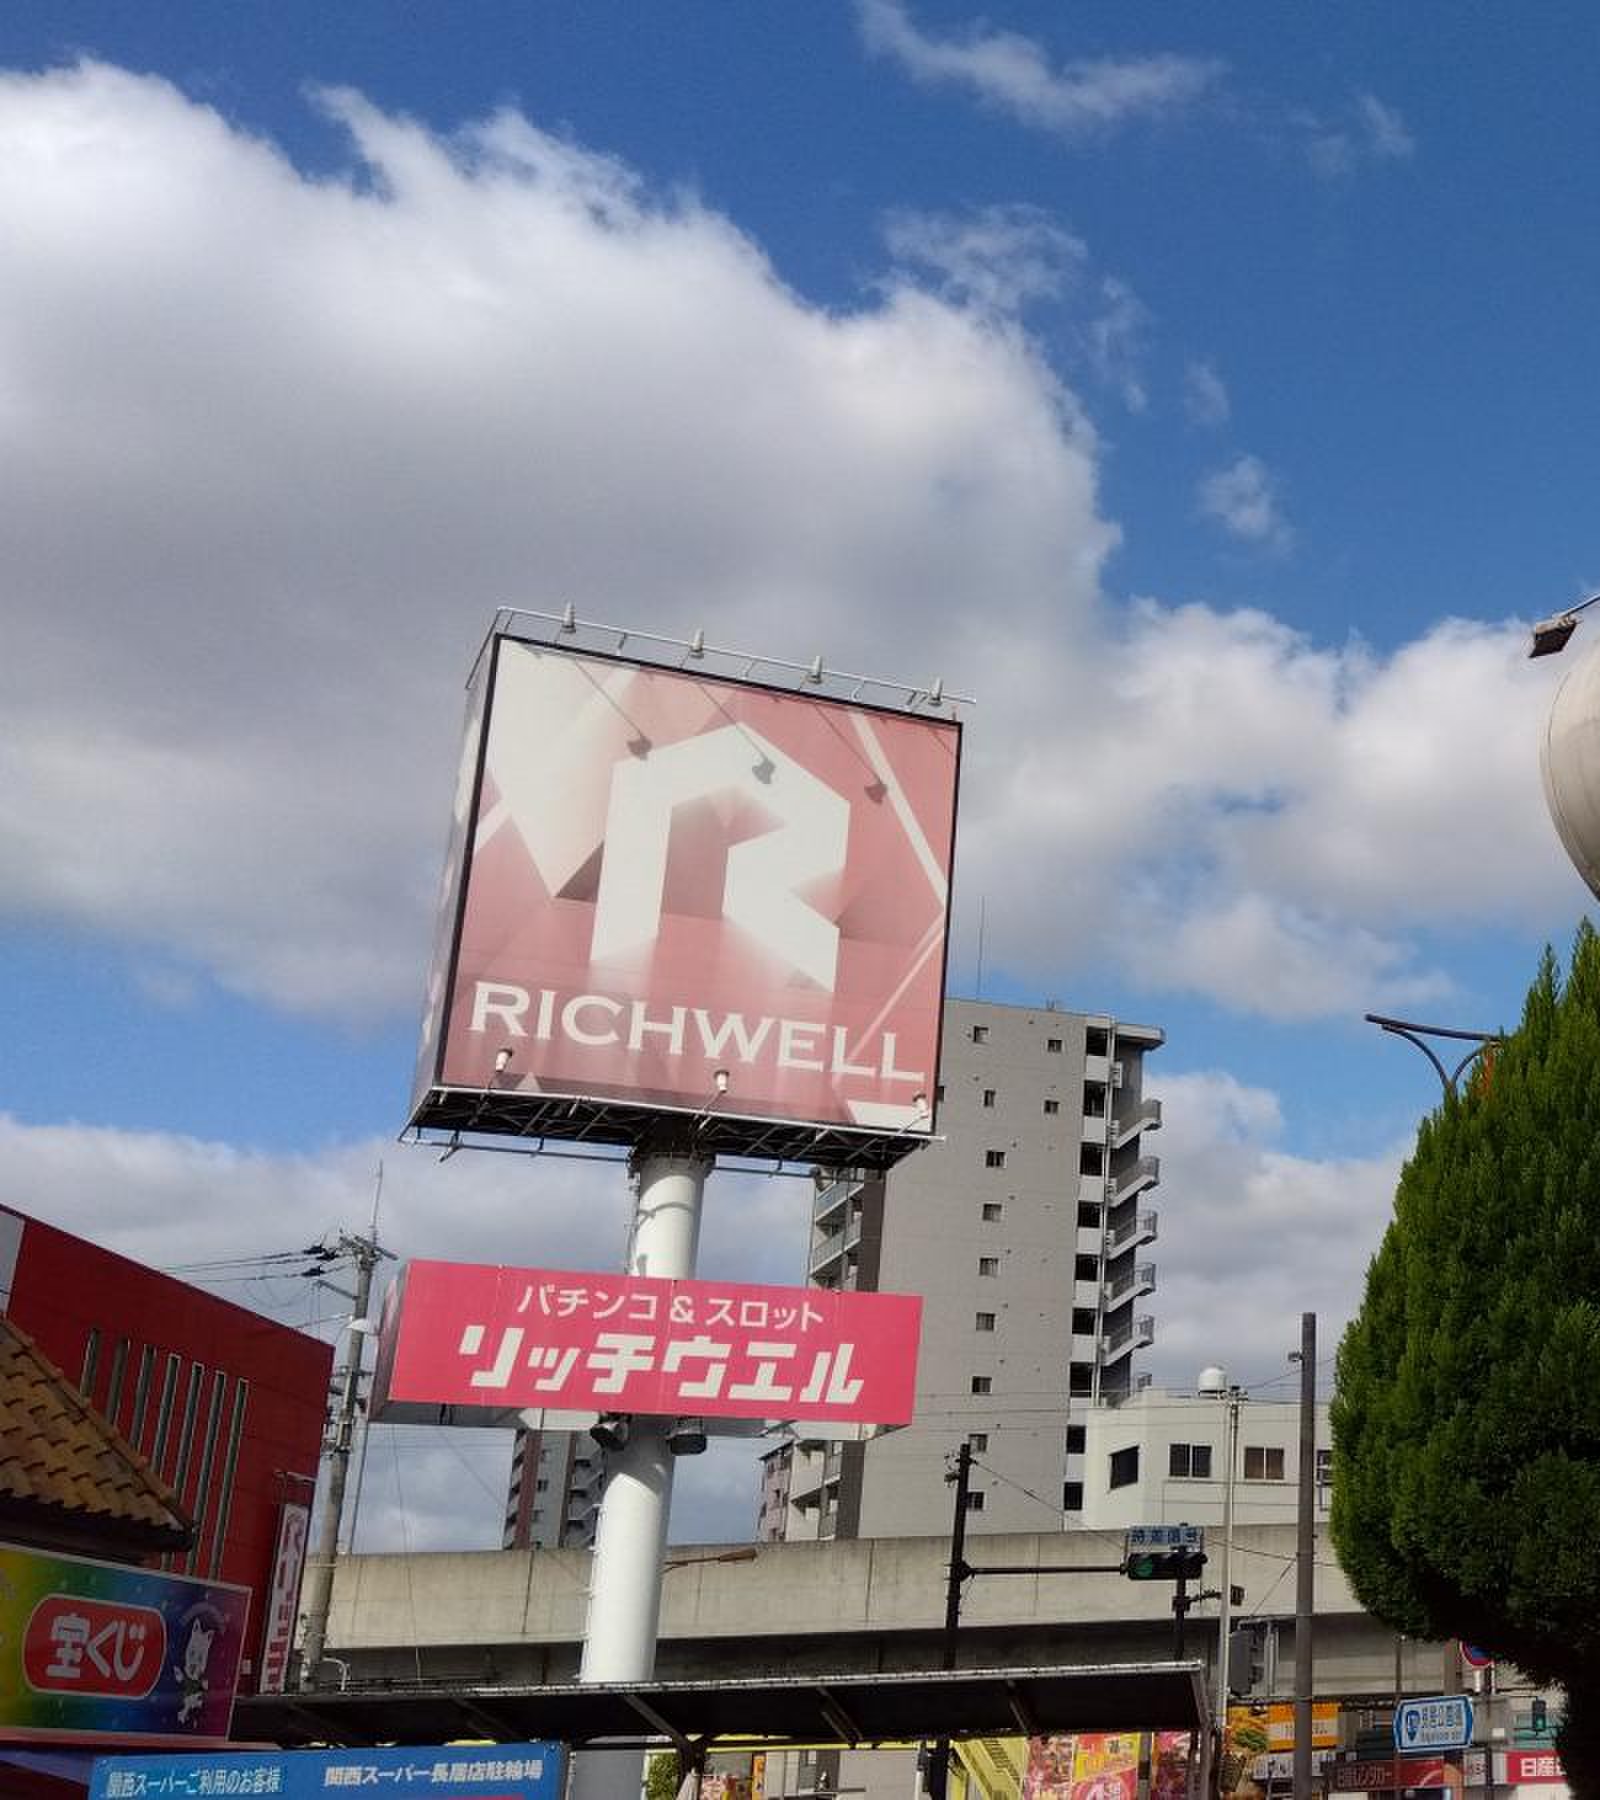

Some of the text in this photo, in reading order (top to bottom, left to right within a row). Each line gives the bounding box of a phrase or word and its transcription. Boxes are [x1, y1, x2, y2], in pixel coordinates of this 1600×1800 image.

[468, 980, 925, 1083] RICHWELL
[458, 1324, 866, 1405] リッチウエル
[44, 1612, 147, 1681] 宝くじ
